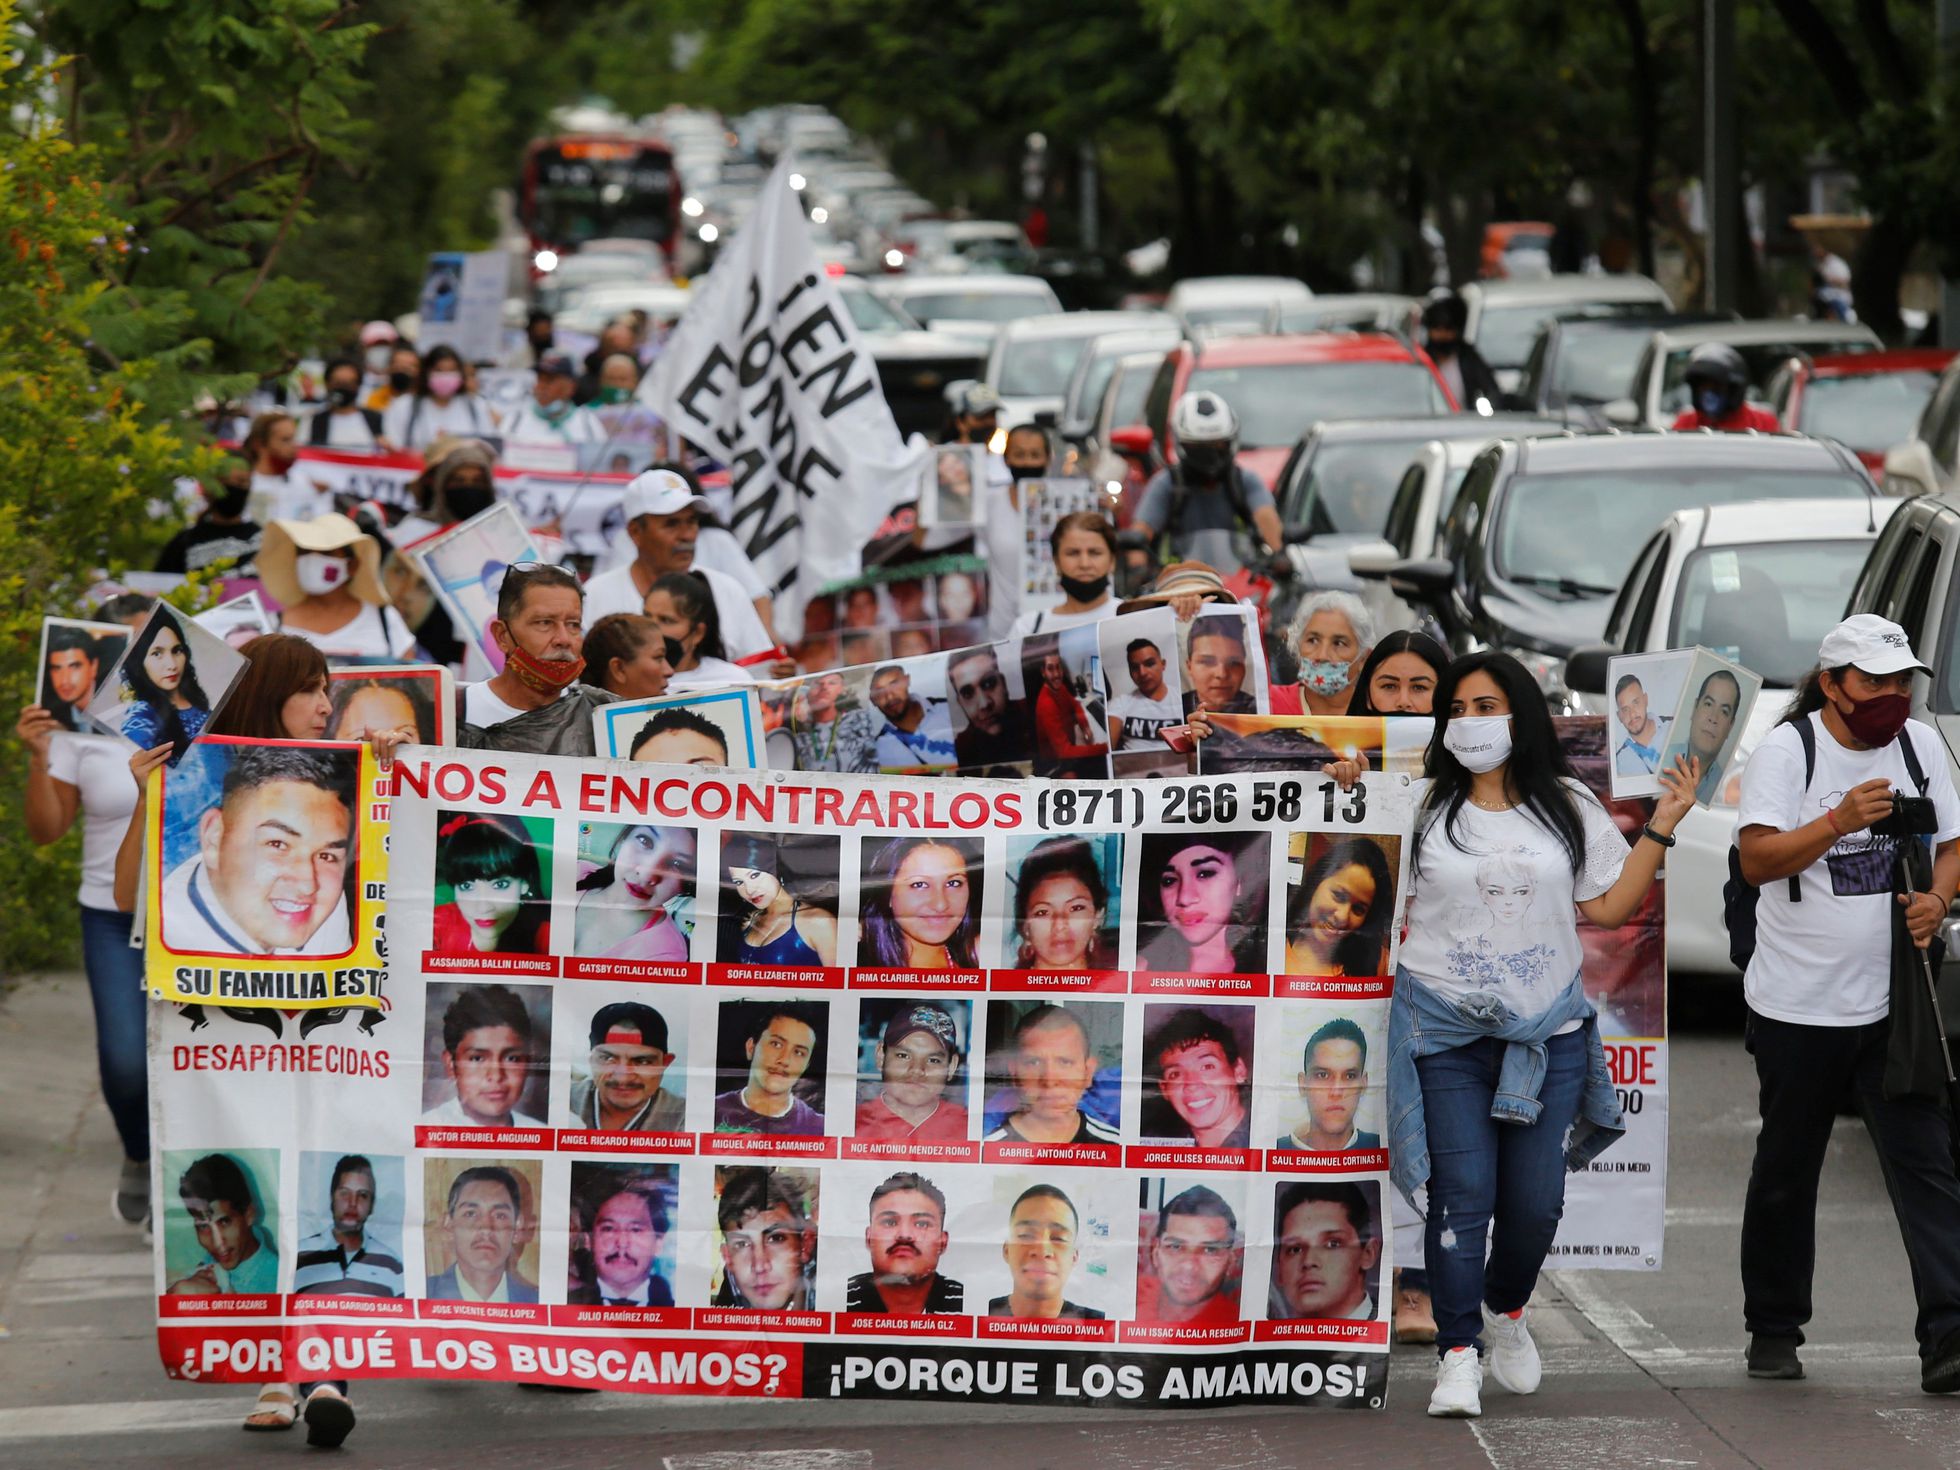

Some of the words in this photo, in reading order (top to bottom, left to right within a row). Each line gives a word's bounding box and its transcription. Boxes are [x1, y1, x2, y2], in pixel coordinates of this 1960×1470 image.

[391, 759, 507, 805] NOS
[520, 770, 562, 810] A
[579, 773, 1022, 830] ENCONTRARLOS
[1037, 787, 1145, 830] (871)
[1162, 783, 1238, 824] 266
[1252, 781, 1301, 823] 58
[1318, 783, 1367, 824] 13
[429, 957, 480, 969] KASSANDRA
[482, 959, 512, 970] BALLIN
[513, 960, 551, 971] LIMONES
[579, 963, 612, 975] GATSBY
[614, 965, 646, 976] CITLALI
[648, 966, 687, 978] CALVILLO
[727, 969, 753, 980] SOFIA
[754, 970, 797, 981] ELIZABETH
[800, 971, 824, 982] ORTIZ
[176, 968, 212, 995] SU
[220, 970, 328, 998] FAMILIA
[334, 968, 381, 997] EST
[856, 973, 878, 983] IRMA
[880, 973, 919, 983] CLARIBEL
[922, 974, 951, 984] LAMAS
[953, 974, 979, 985] LOPEZ
[1027, 976, 1059, 985] SHEYLA
[1061, 976, 1092, 986] WENDY
[1150, 978, 1184, 988] JESSICA
[1186, 979, 1217, 989] VIANEY
[1219, 979, 1252, 990] ORTEGA
[1290, 981, 1321, 991] REBECA
[1323, 982, 1362, 993] CORTINAS
[428, 1131, 459, 1141] VICTOR
[496, 1134, 541, 1144] ANGUIANO
[561, 1135, 588, 1145] ANGEL
[590, 1136, 628, 1146] RICARDO
[630, 1137, 667, 1147] HIDALGO
[669, 1138, 692, 1148] LUNA
[712, 1139, 745, 1149] MIGUEL
[746, 1140, 774, 1150] ANGEL
[775, 1141, 825, 1152] SAMANIEGO
[851, 1144, 868, 1154] NOE
[870, 1144, 907, 1154] ANTONIO
[909, 1145, 943, 1155] MENDEZ
[945, 1146, 971, 1156] ROMO
[1000, 1148, 1034, 1158] GABRIEL
[1036, 1149, 1074, 1159] ANTONIO
[1076, 1150, 1107, 1160] FAVELA
[1144, 1153, 1171, 1163] JORGE
[1173, 1154, 1203, 1164] ULISES
[1205, 1155, 1245, 1165] GRIJALVA
[1272, 1155, 1293, 1165] SAUL
[1296, 1156, 1341, 1166] EMMANUEL
[1343, 1155, 1375, 1166] CORTINAS
[1592, 1162, 1613, 1172] RELOJ
[1616, 1162, 1625, 1172] EN
[1628, 1162, 1651, 1172] MEDIO
[1615, 1246, 1640, 1257] BRAZO
[178, 1300, 210, 1311] MIGUEL
[212, 1300, 235, 1311] ORTIZ
[317, 1300, 338, 1310] ALAN
[432, 1304, 452, 1315] JOSE
[453, 1306, 485, 1317] VICENTE
[486, 1307, 509, 1318] CRUZ
[510, 1308, 536, 1319] LOPEZ
[577, 1310, 602, 1321] JULIO
[603, 1310, 641, 1322] RAMÍREZ
[703, 1313, 723, 1324] LUIS
[724, 1314, 761, 1325] ENRIQUE
[785, 1316, 823, 1327] ROMERO
[852, 1318, 874, 1328] JOSE
[876, 1319, 909, 1329] CARLOS
[910, 1317, 936, 1330] MEJÍA
[937, 1320, 957, 1331] GLZ.
[989, 1322, 1018, 1332] EDGAR
[1019, 1321, 1040, 1333] IVÁN
[1041, 1324, 1073, 1334] OVIEDO
[1075, 1325, 1104, 1335] DAVILA
[1127, 1327, 1147, 1337] IVAN
[1149, 1327, 1174, 1338] ISSAC
[1175, 1328, 1208, 1338] ALCALA
[1273, 1325, 1292, 1335] JOSE
[1317, 1325, 1340, 1336] CRUZ
[1341, 1326, 1368, 1337] LOPEZ
[180, 1338, 283, 1379] ¿POR
[297, 1332, 396, 1373] QUÉ
[409, 1338, 497, 1372] LOS
[508, 1344, 787, 1394] BUSCAMOS?
[830, 1356, 1039, 1397] ¡PORQUE
[1055, 1363, 1145, 1399] LOS
[1159, 1361, 1367, 1400] AMAMOS!
